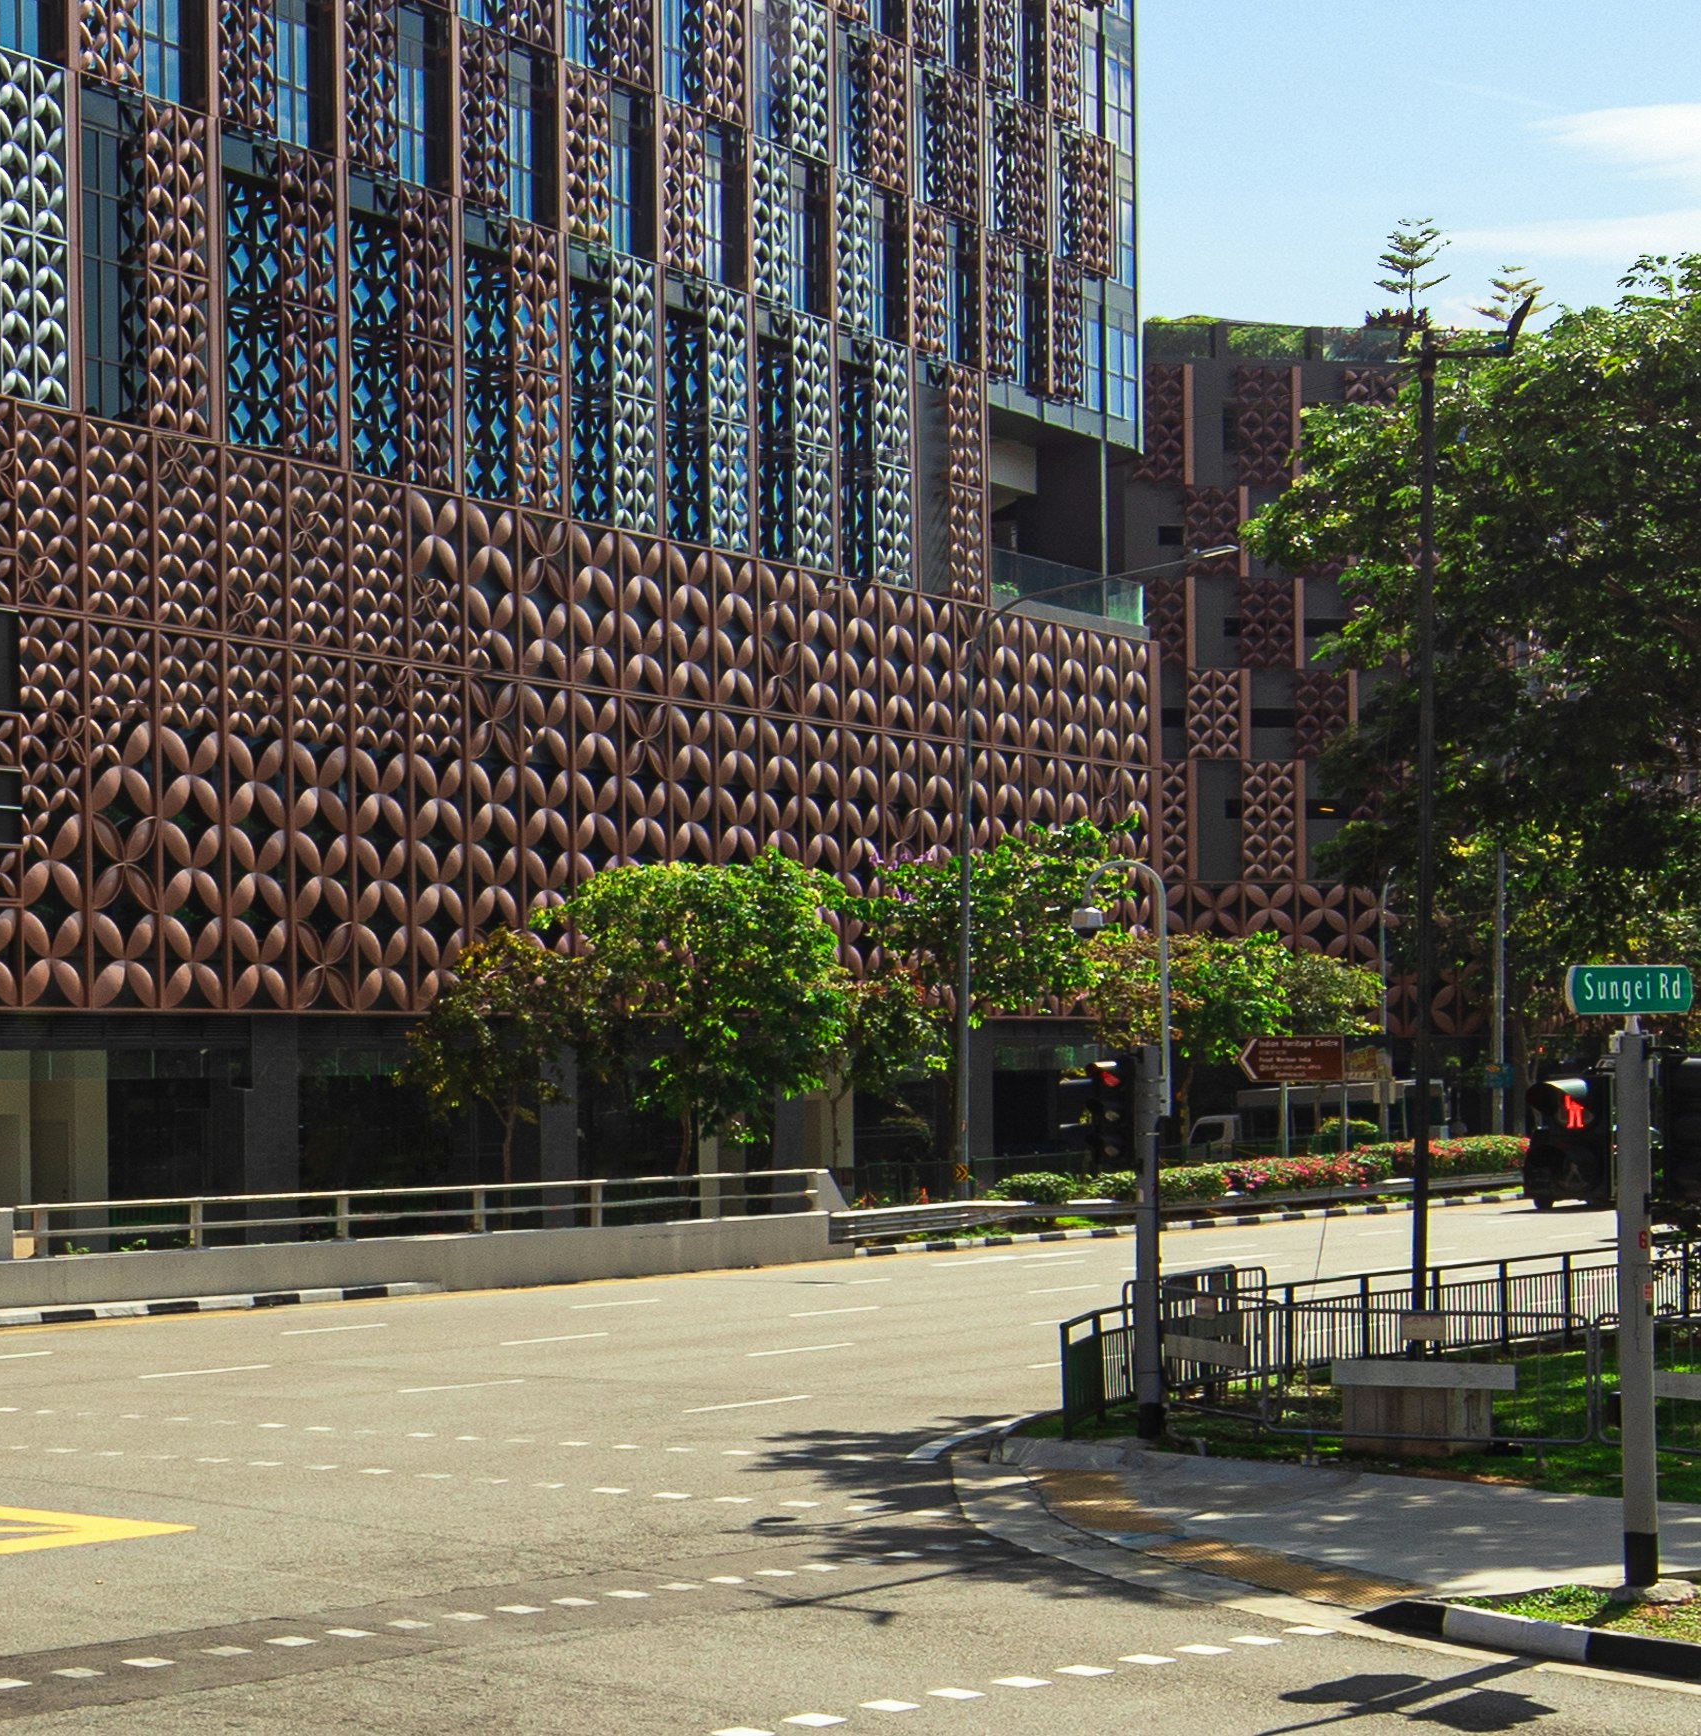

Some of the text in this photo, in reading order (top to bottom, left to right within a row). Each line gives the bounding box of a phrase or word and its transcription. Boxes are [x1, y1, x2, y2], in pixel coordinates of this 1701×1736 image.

[1583, 972, 1682, 1008] Sungei Rd
[1281, 1039, 1312, 1049] Heritage
